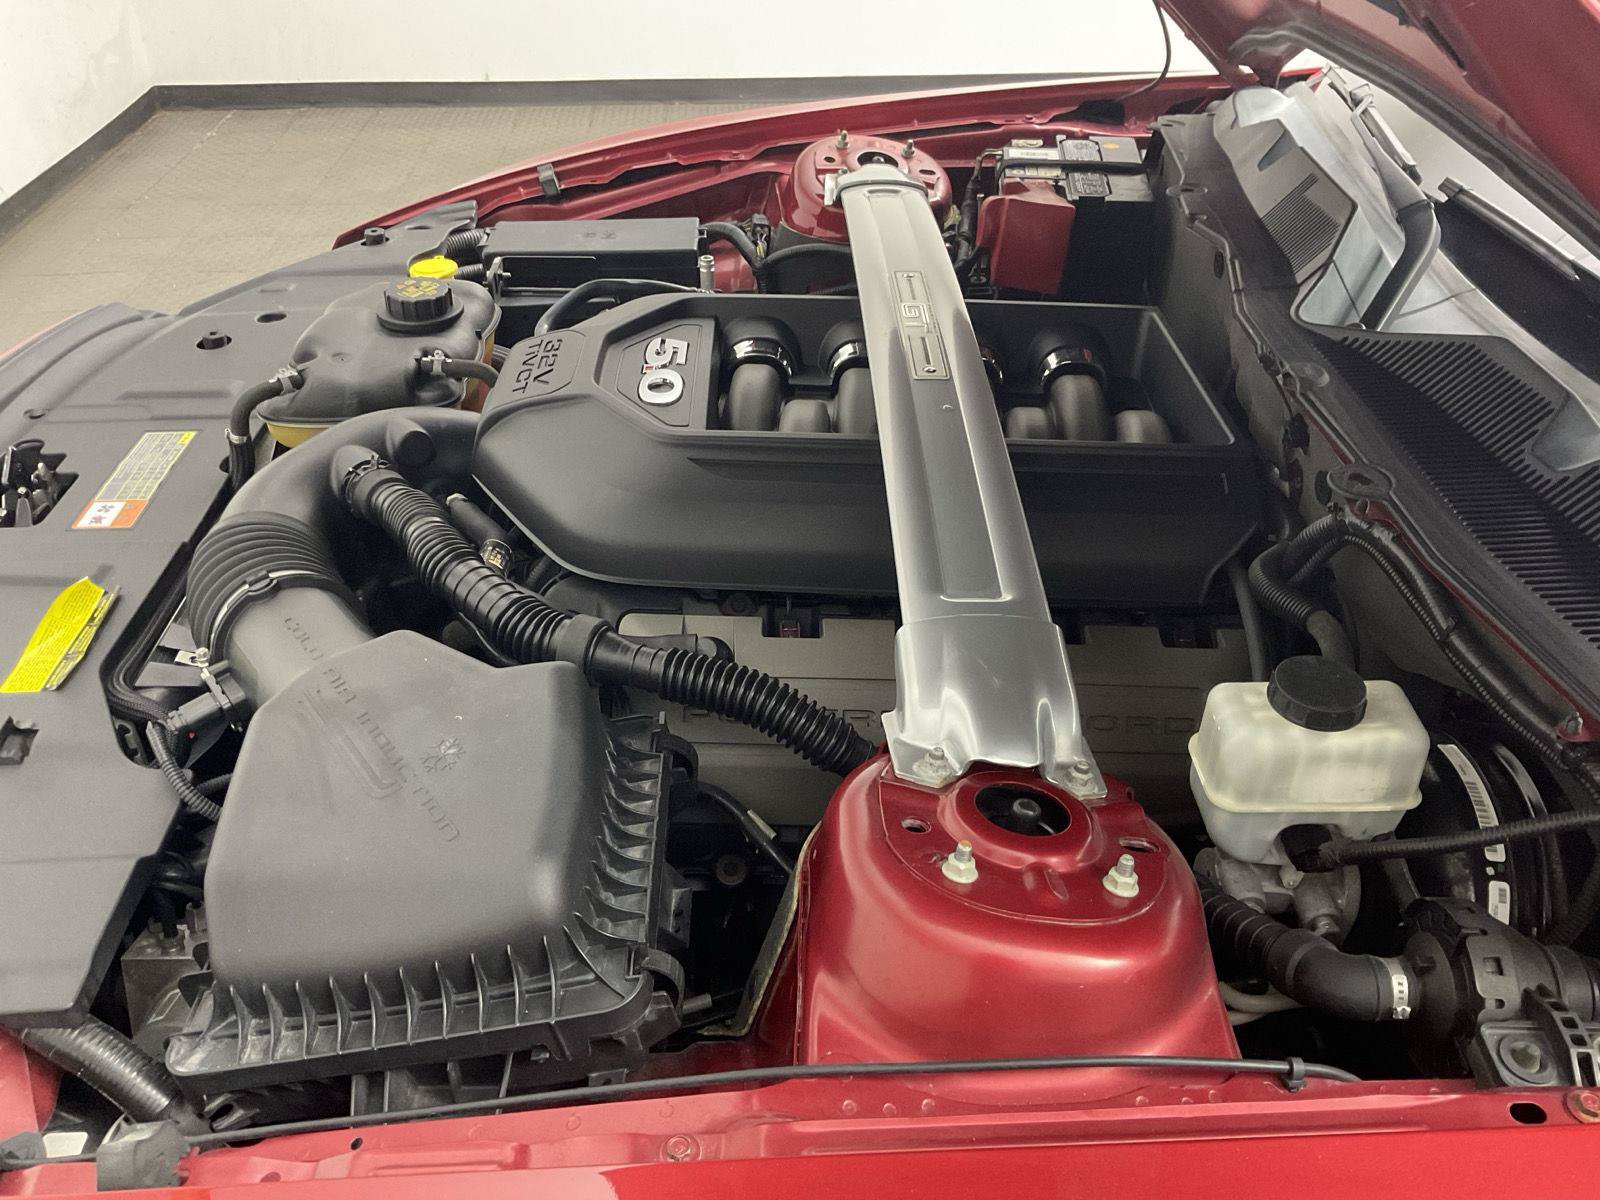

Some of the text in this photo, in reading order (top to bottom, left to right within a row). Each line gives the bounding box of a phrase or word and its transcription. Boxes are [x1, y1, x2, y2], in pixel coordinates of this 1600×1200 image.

[533, 338, 563, 386] 32V
[323, 668, 357, 704] AIR
[1081, 714, 1195, 735] ORD
